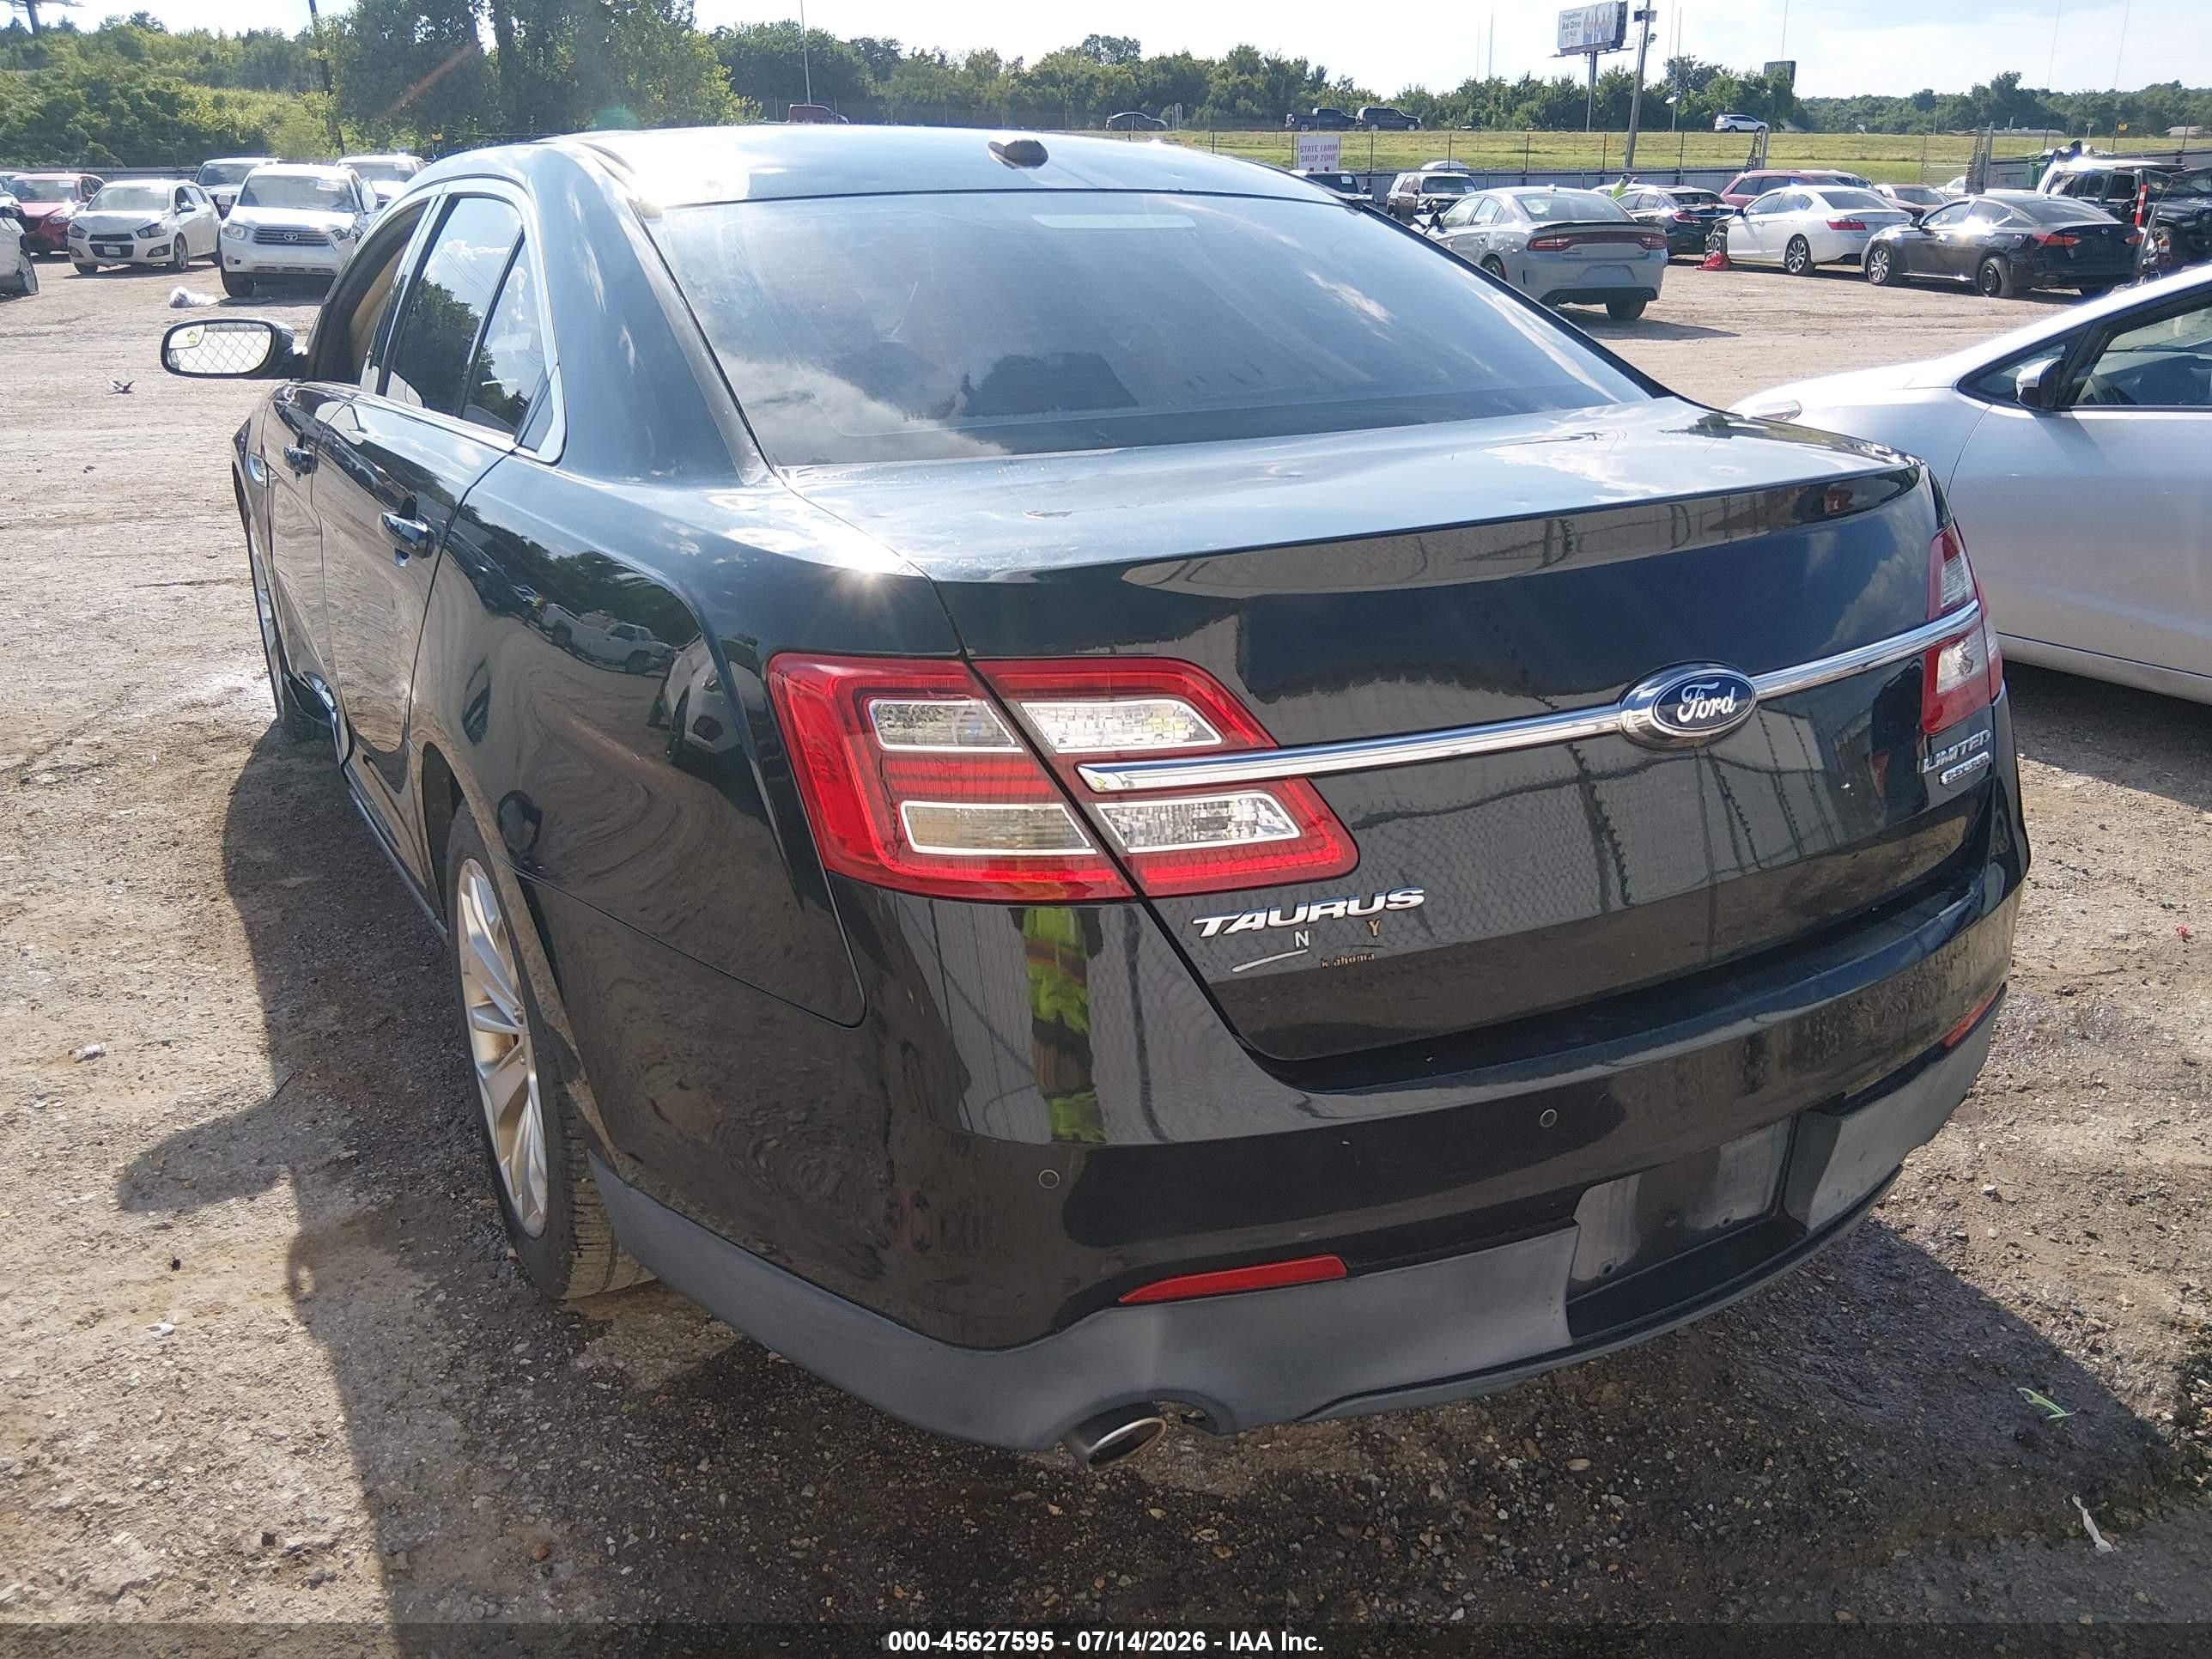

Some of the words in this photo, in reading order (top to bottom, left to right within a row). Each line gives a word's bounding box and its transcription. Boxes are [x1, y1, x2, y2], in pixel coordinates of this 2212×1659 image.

[1300, 155, 1318, 163] DROP
[1320, 153, 1337, 161] ZONE
[1320, 143, 1338, 152] FARM
[1676, 682, 1737, 723] Ford
[1920, 729, 1991, 774] LIMITED
[1192, 886, 1425, 938] TAURUS
[1293, 930, 1310, 948] N
[1367, 920, 1381, 937] Y
